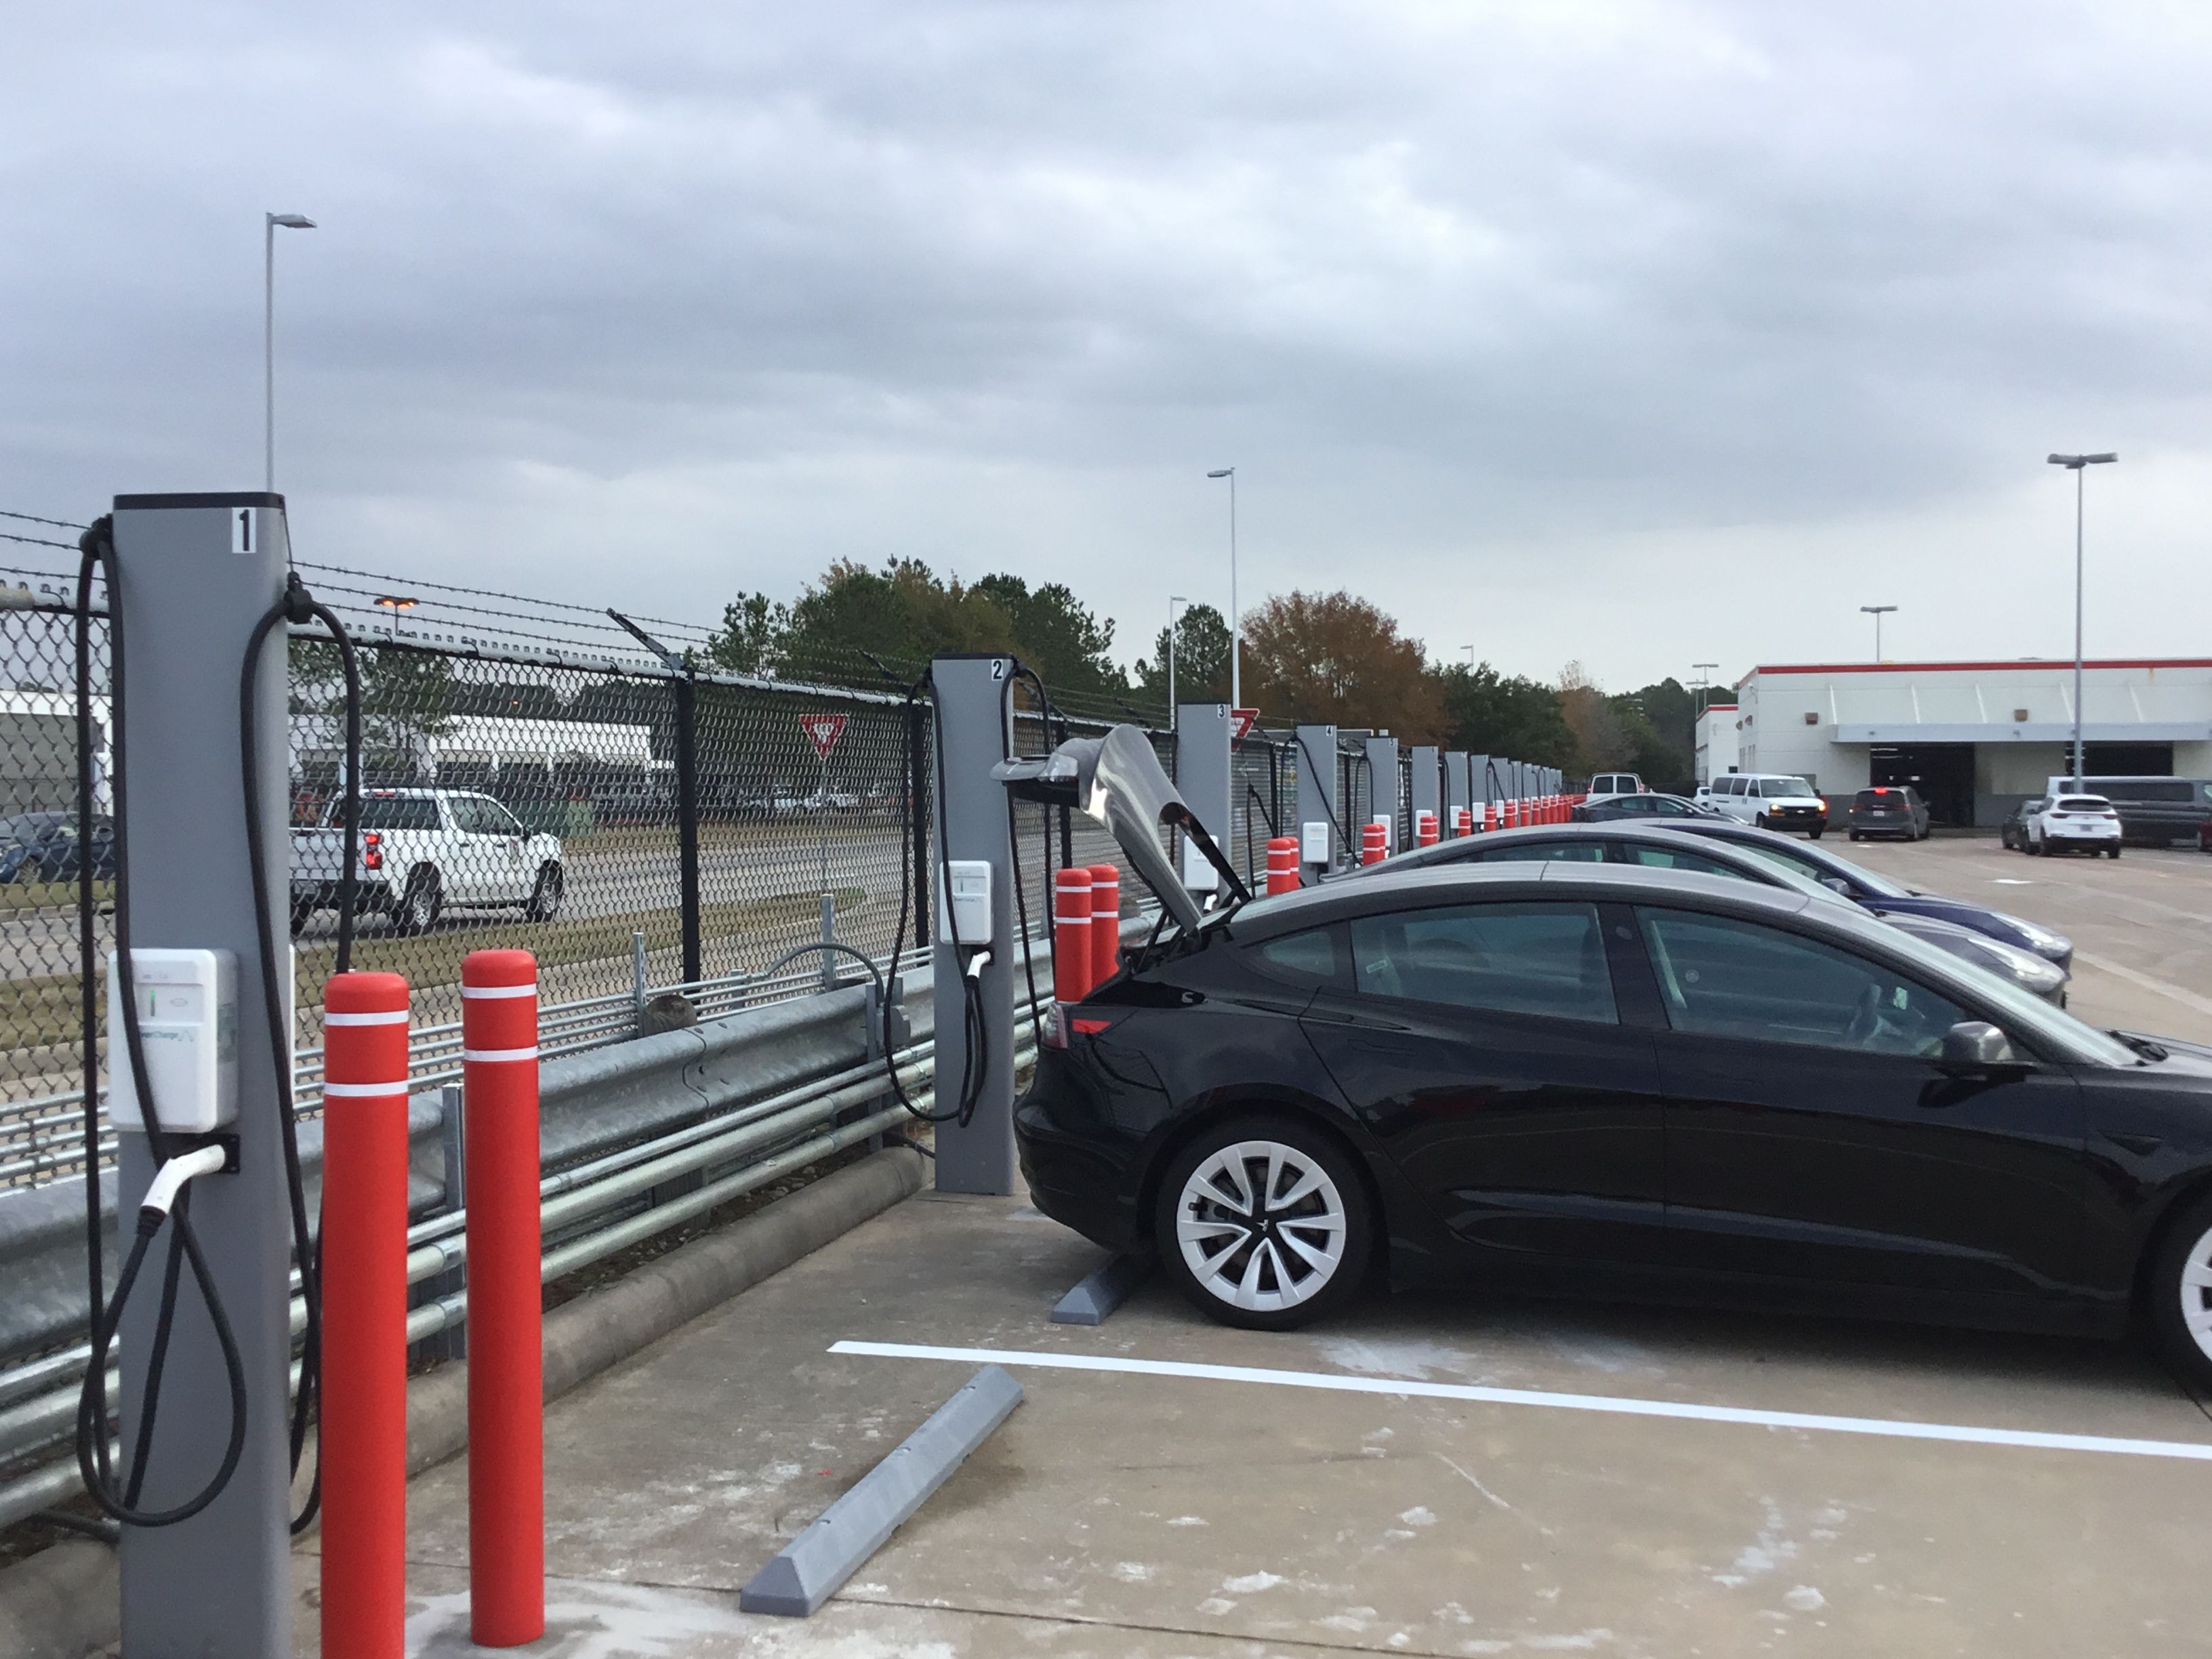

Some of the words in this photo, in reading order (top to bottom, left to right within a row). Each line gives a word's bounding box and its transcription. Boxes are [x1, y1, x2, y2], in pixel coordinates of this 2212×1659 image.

[239, 509, 250, 552] 1
[993, 660, 1002, 680] 2
[1219, 704, 1225, 718] 3
[1327, 726, 1331, 735] 4
